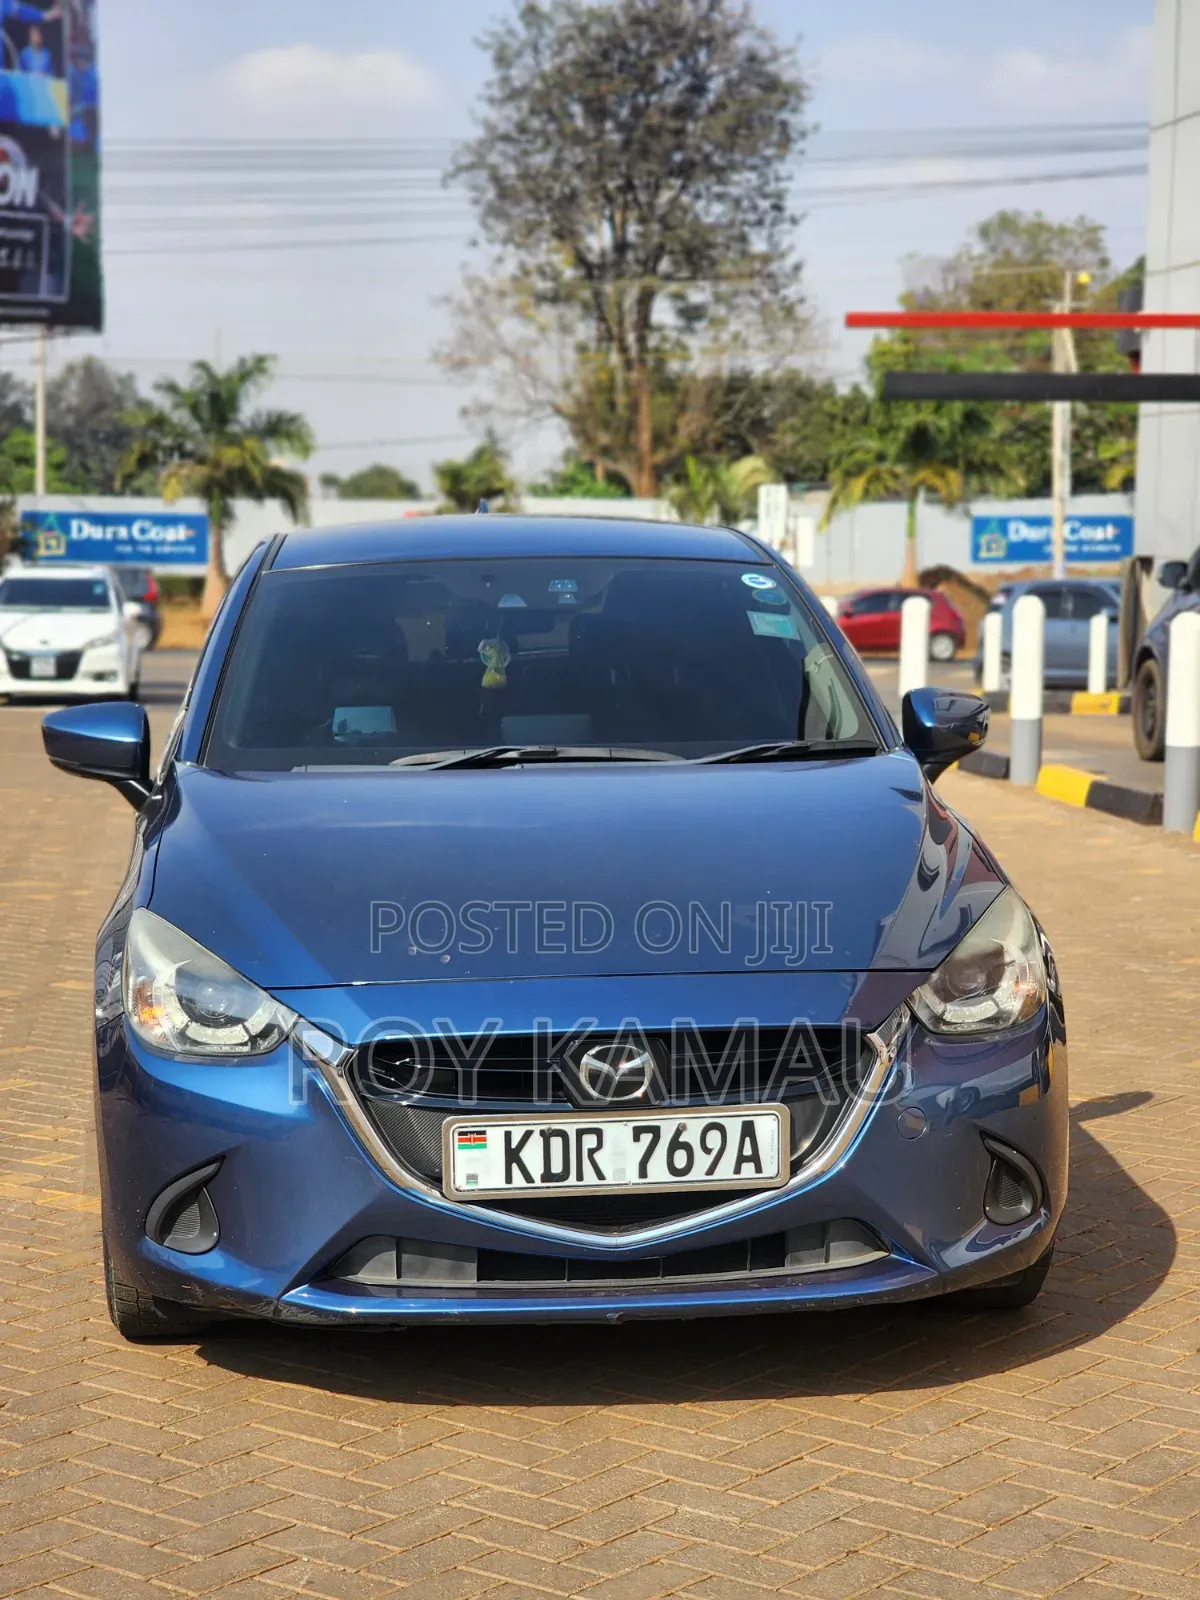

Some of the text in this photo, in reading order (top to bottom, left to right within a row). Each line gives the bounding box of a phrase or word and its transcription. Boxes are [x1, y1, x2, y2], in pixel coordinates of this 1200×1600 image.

[1007, 518, 1061, 543] Dur
[503, 1128, 607, 1186] KDR
[631, 1118, 764, 1181] 769A
